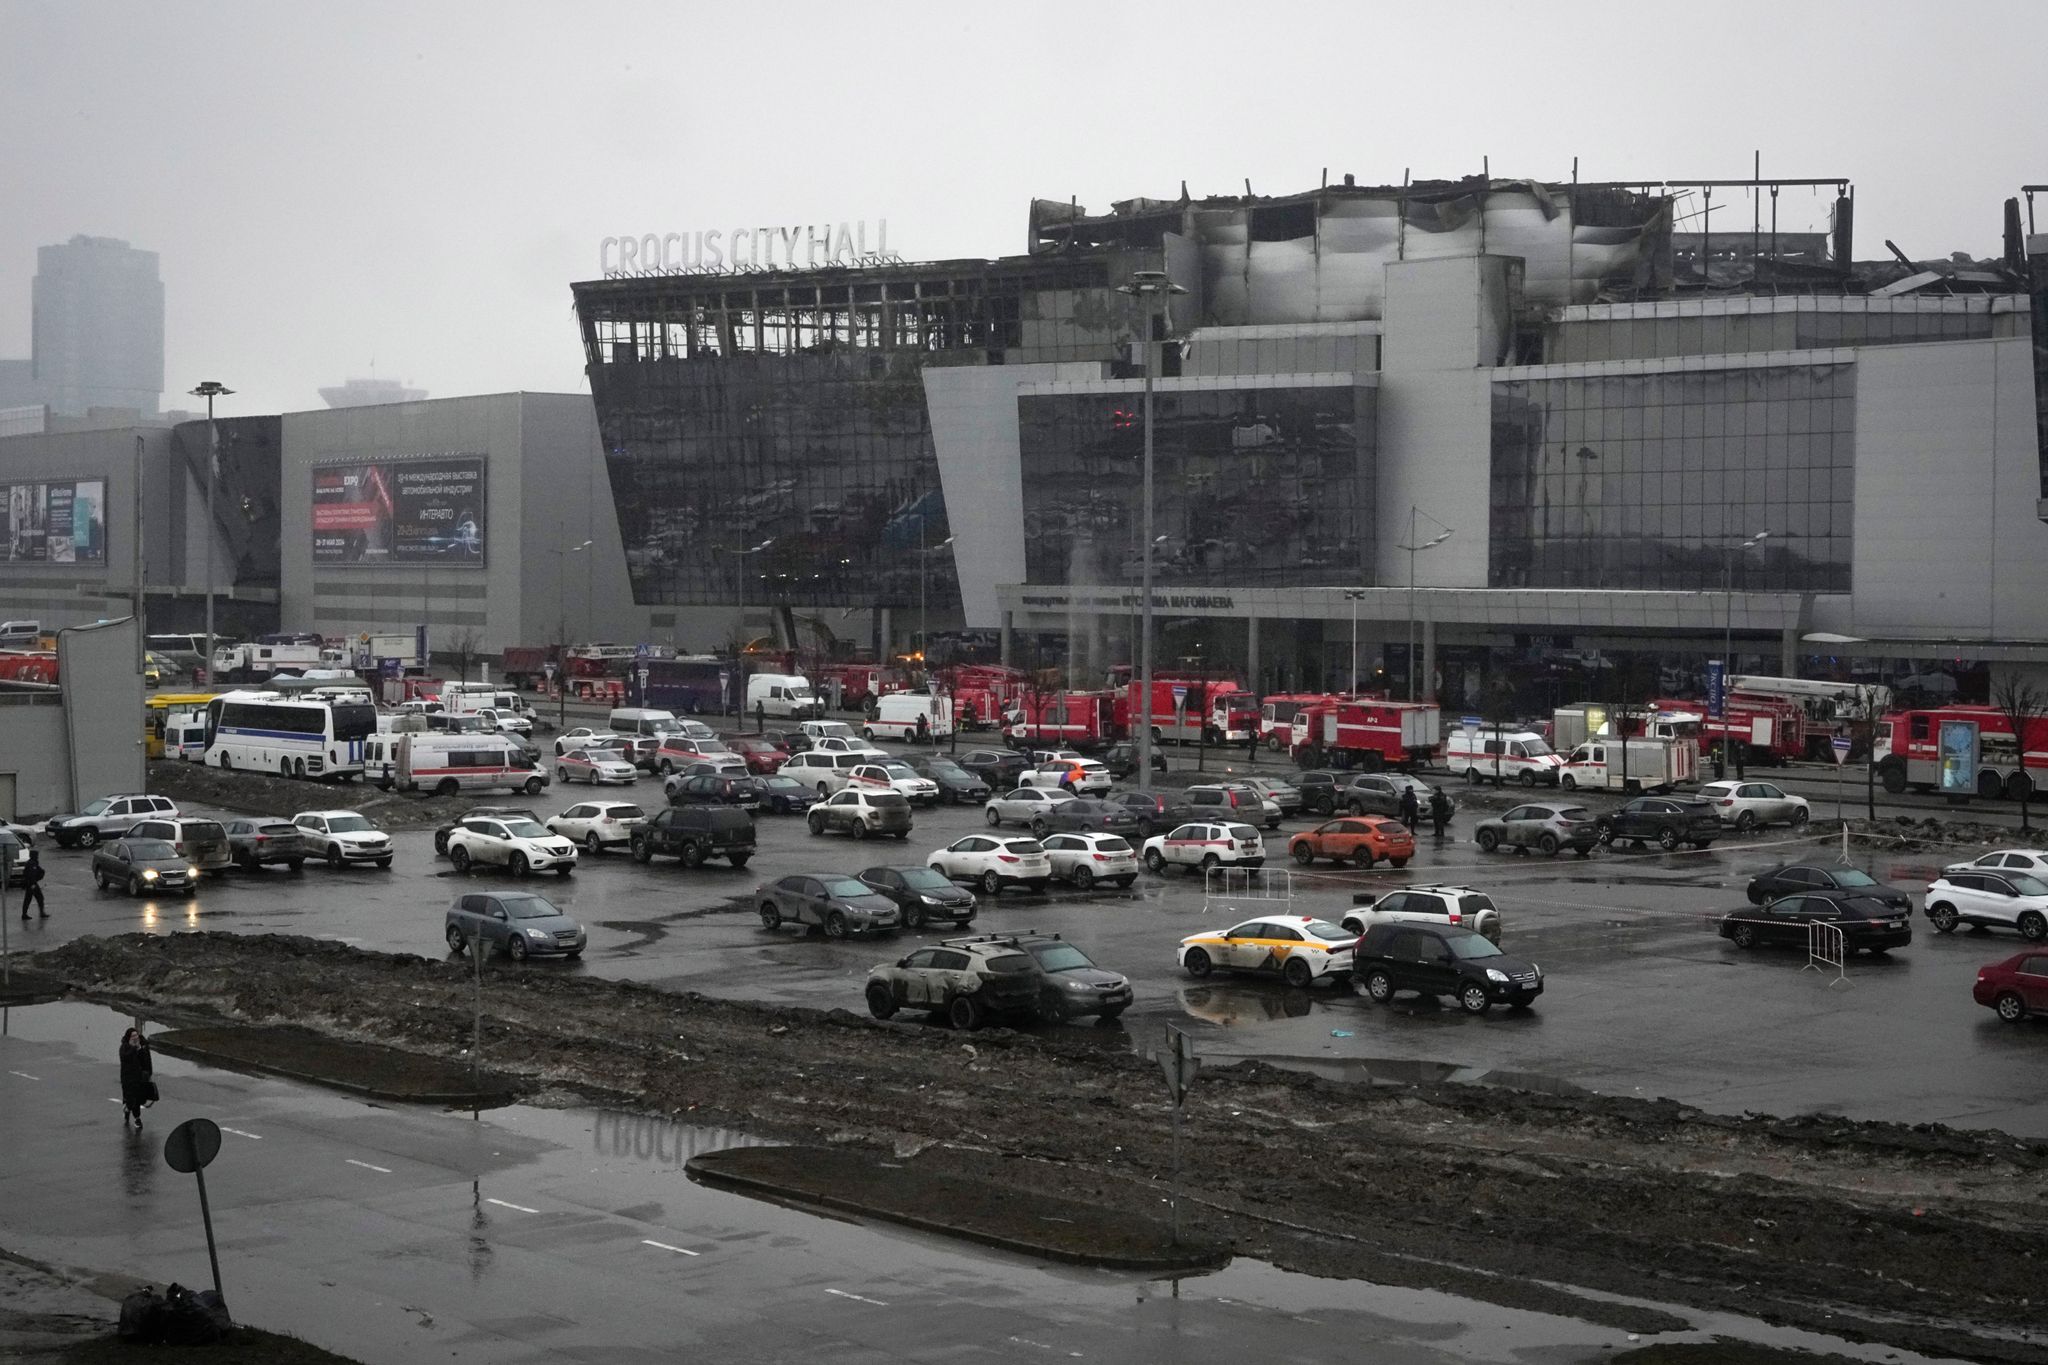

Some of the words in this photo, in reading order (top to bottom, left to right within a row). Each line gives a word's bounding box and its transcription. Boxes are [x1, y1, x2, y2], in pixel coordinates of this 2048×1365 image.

[600, 228, 722, 273] CROCUS
[729, 226, 801, 266] CITY
[808, 219, 898, 262] HALL
[419, 508, 453, 520] ИНТЕРАВТО
